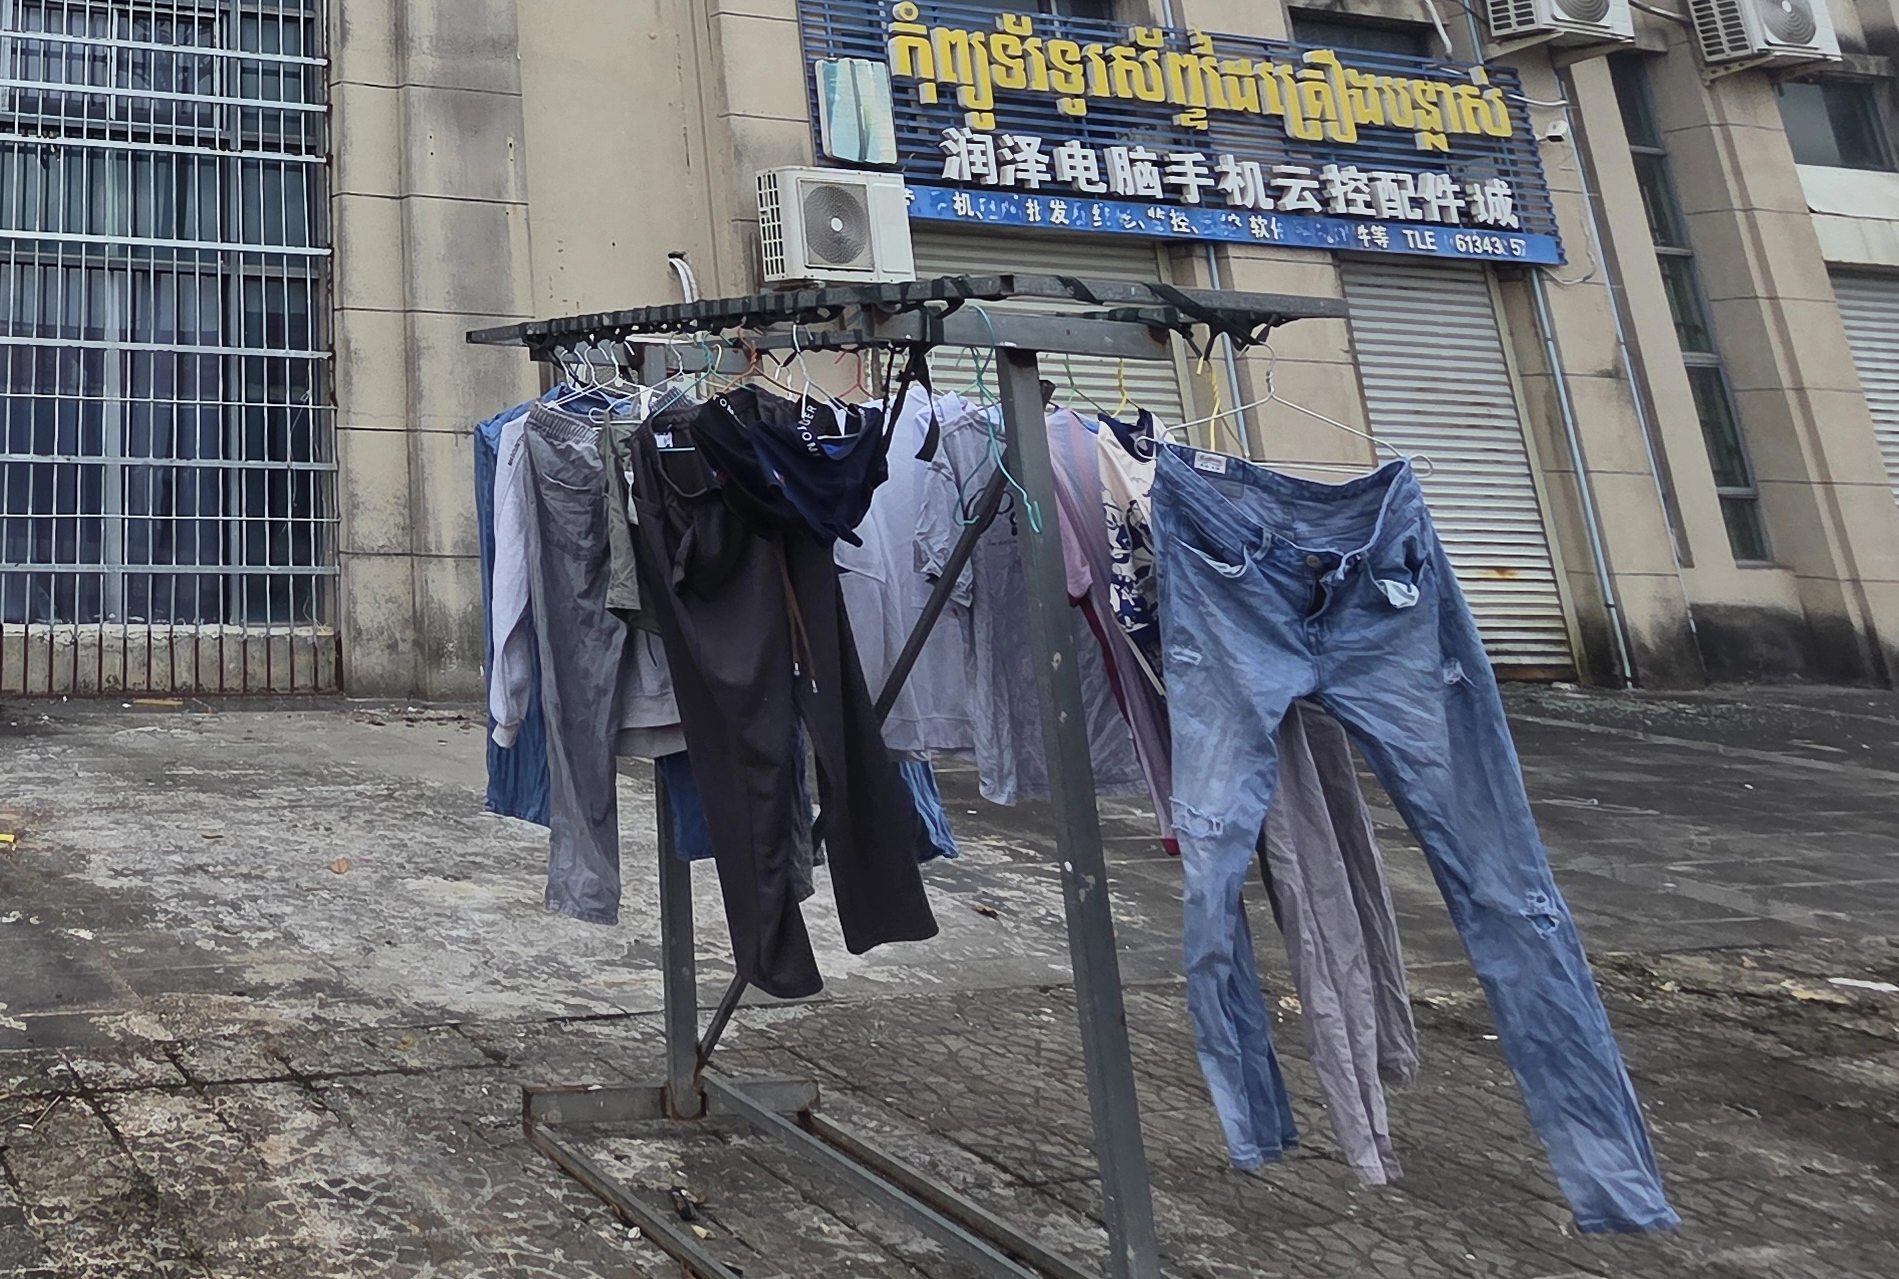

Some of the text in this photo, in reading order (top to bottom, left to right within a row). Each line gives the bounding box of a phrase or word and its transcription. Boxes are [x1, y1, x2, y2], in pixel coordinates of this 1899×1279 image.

[939, 126, 1520, 229] 润泽电脑手机云控配件城
[1402, 229, 1438, 250] TLE
